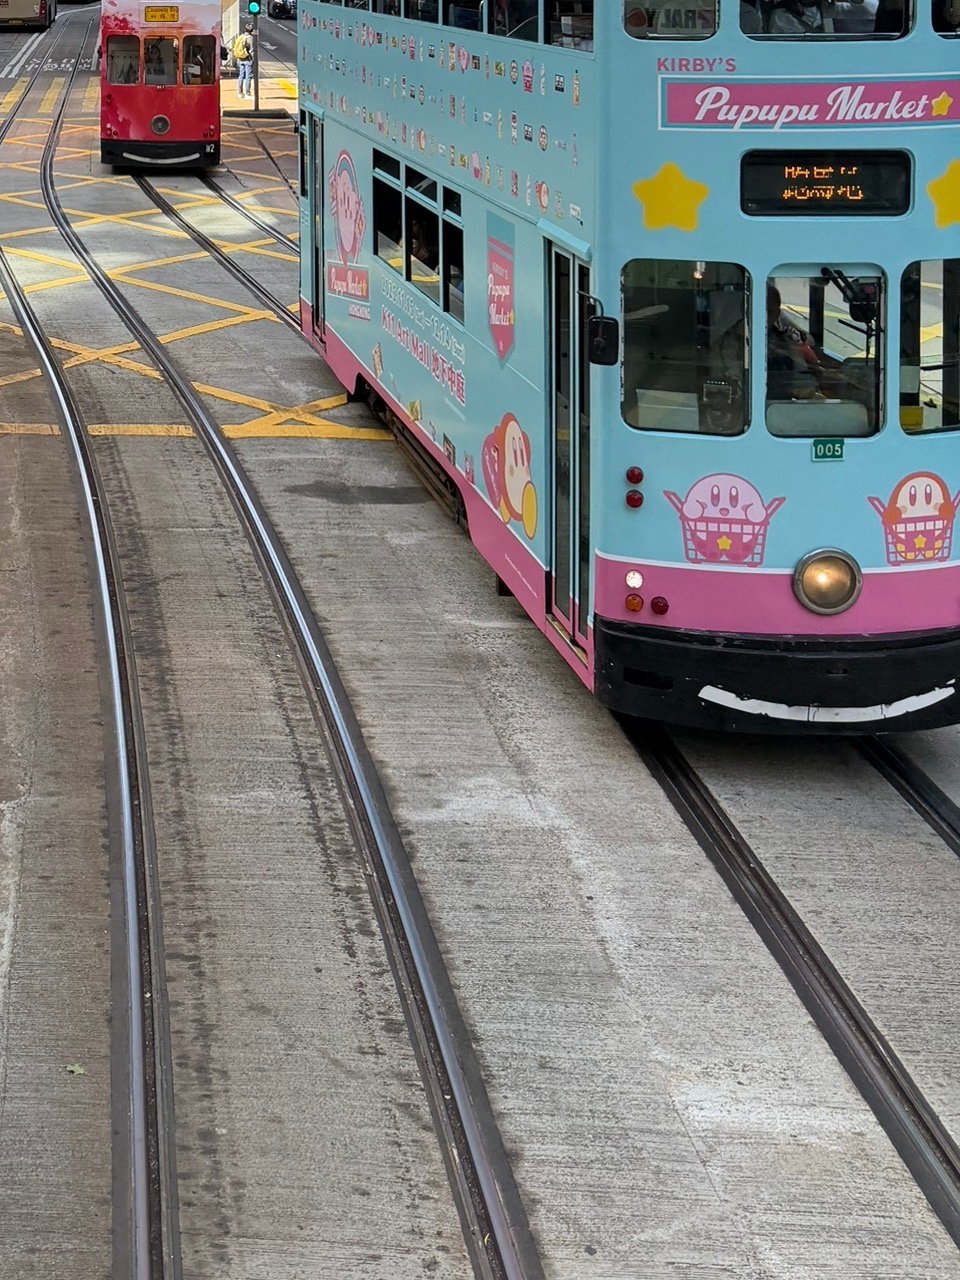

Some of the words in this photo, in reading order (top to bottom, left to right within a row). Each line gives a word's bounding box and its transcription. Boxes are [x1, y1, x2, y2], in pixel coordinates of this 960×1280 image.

[656, 57, 737, 72] KIRBY’S
[695, 86, 819, 131] Pupupu
[825, 85, 930, 121] Market
[396, 318, 411, 353] Art
[410, 329, 430, 370] Mall
[816, 443, 842, 456] 005
